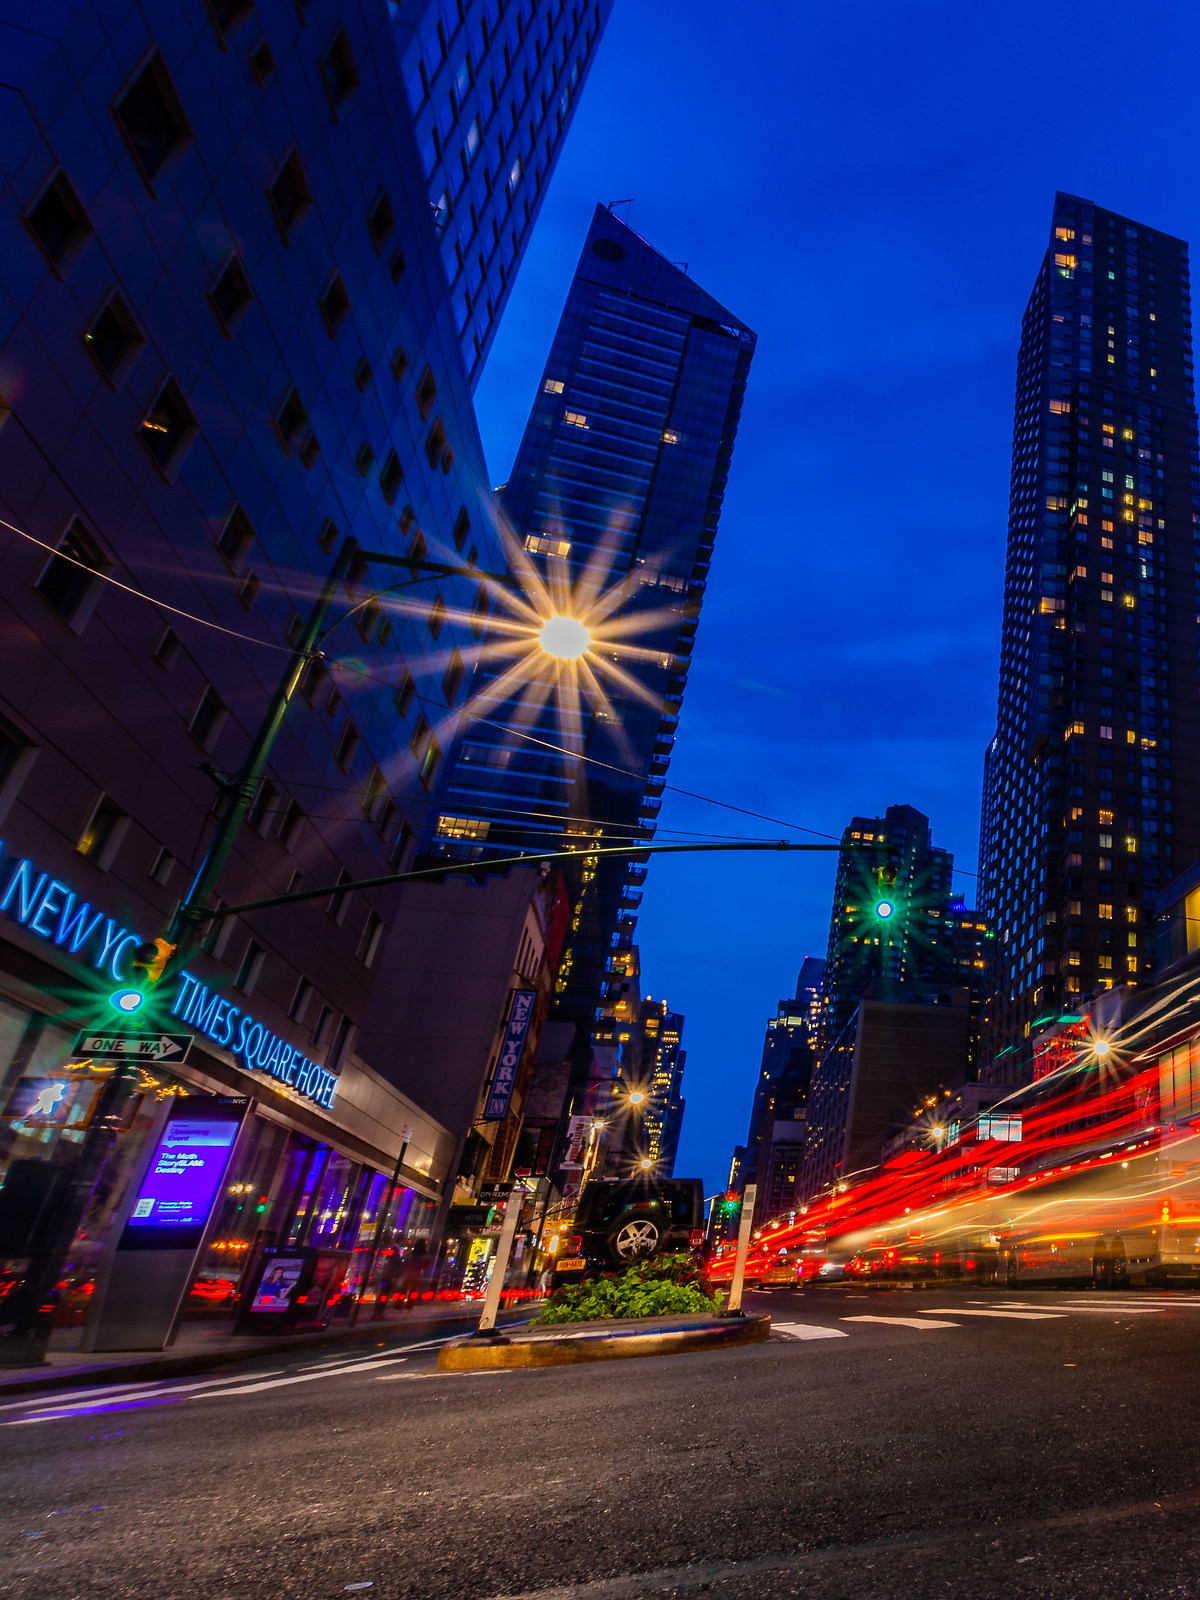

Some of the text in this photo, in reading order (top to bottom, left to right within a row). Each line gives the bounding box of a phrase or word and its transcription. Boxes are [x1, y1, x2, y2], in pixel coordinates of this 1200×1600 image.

[0, 859, 105, 953] NEW
[510, 995, 533, 1035] NEW
[91, 1039, 174, 1054] ONE WAY
[172, 970, 340, 1110] TIMES SQUARE HOTEL
[493, 1041, 521, 1095] YORK
[161, 1152, 198, 1160] The Moth
